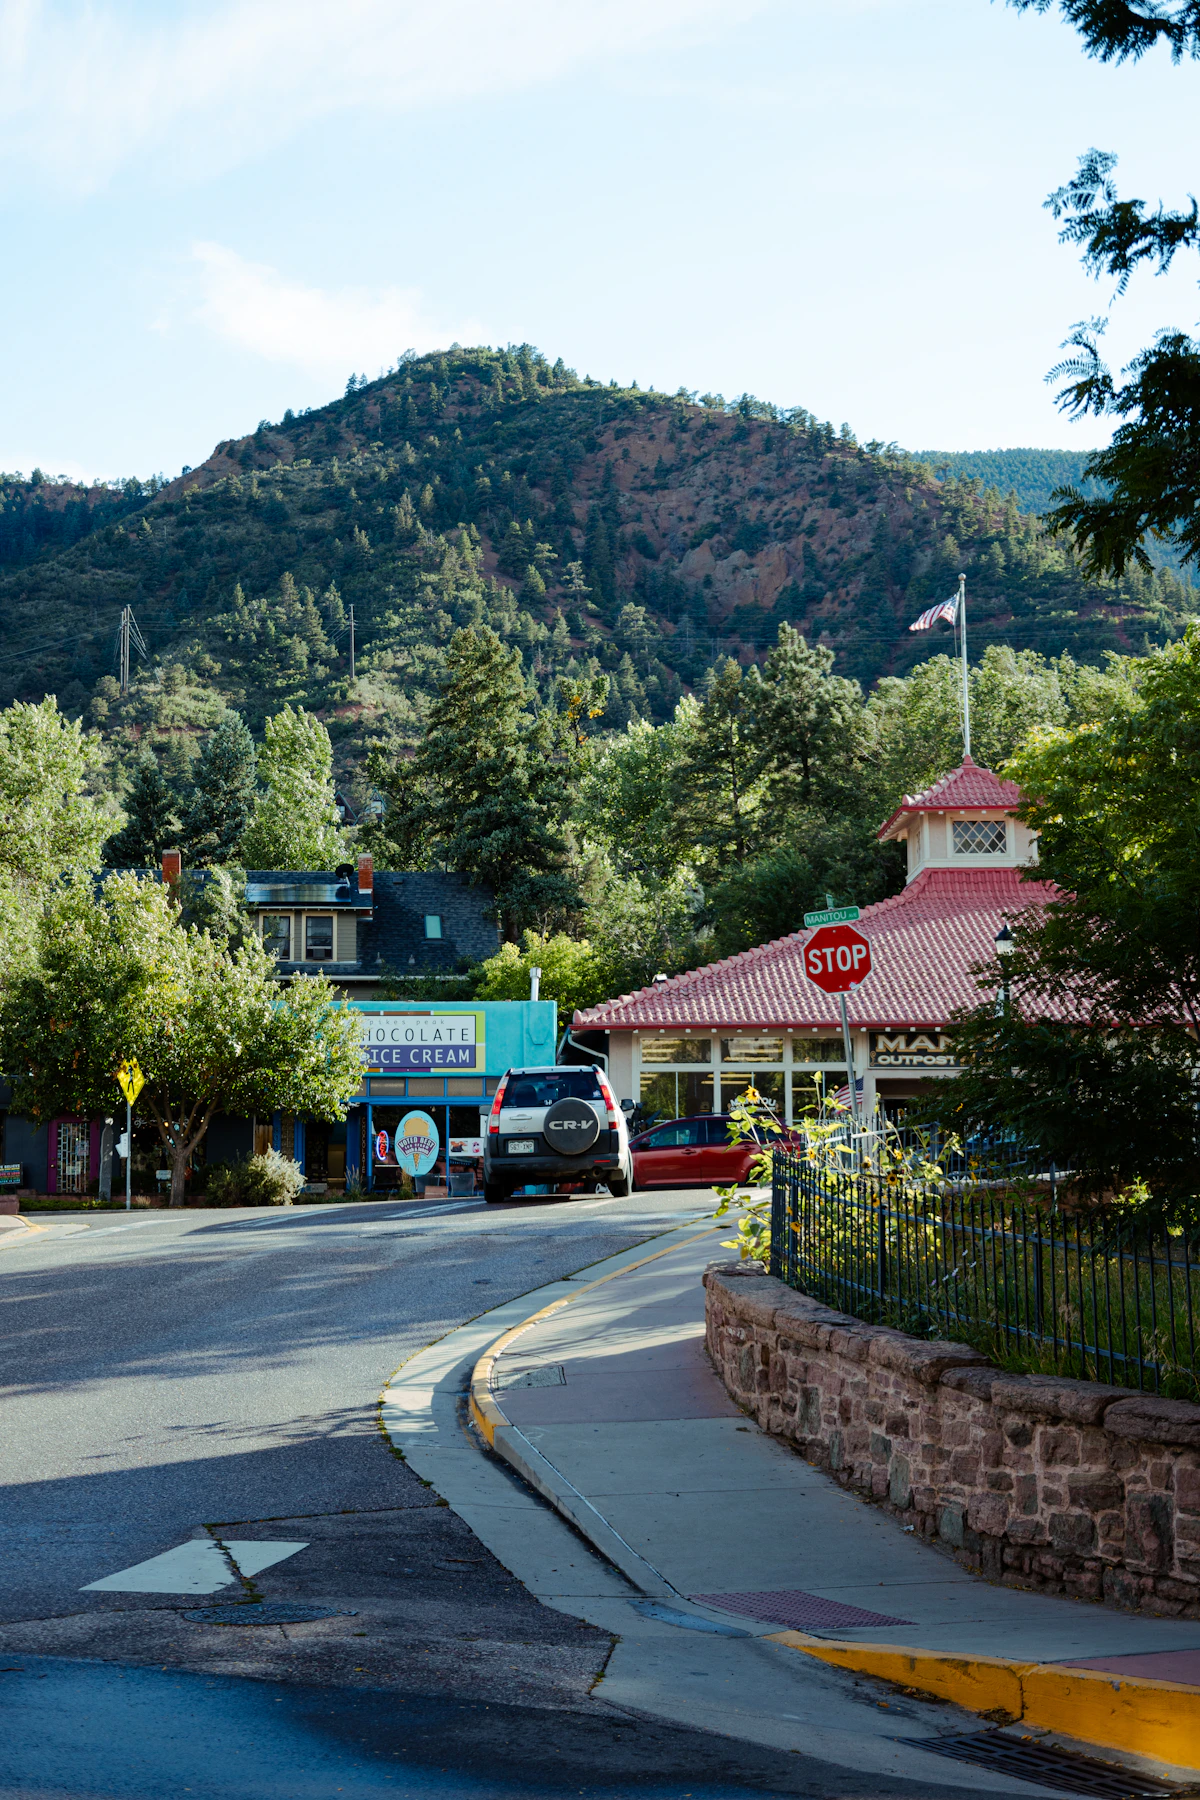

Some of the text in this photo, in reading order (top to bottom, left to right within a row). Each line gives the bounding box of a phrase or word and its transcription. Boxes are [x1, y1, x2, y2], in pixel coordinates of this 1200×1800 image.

[806, 911, 847, 924] MANITOU
[808, 944, 867, 975] STOP
[369, 1018, 445, 1027] pikes peak
[362, 1028, 469, 1042] HOCOLATE
[371, 1049, 470, 1064] ICE CREAM
[877, 1055, 955, 1066] OUTPOST
[548, 1120, 595, 1130] CR-V
[399, 1136, 435, 1148] VOTED BEST
